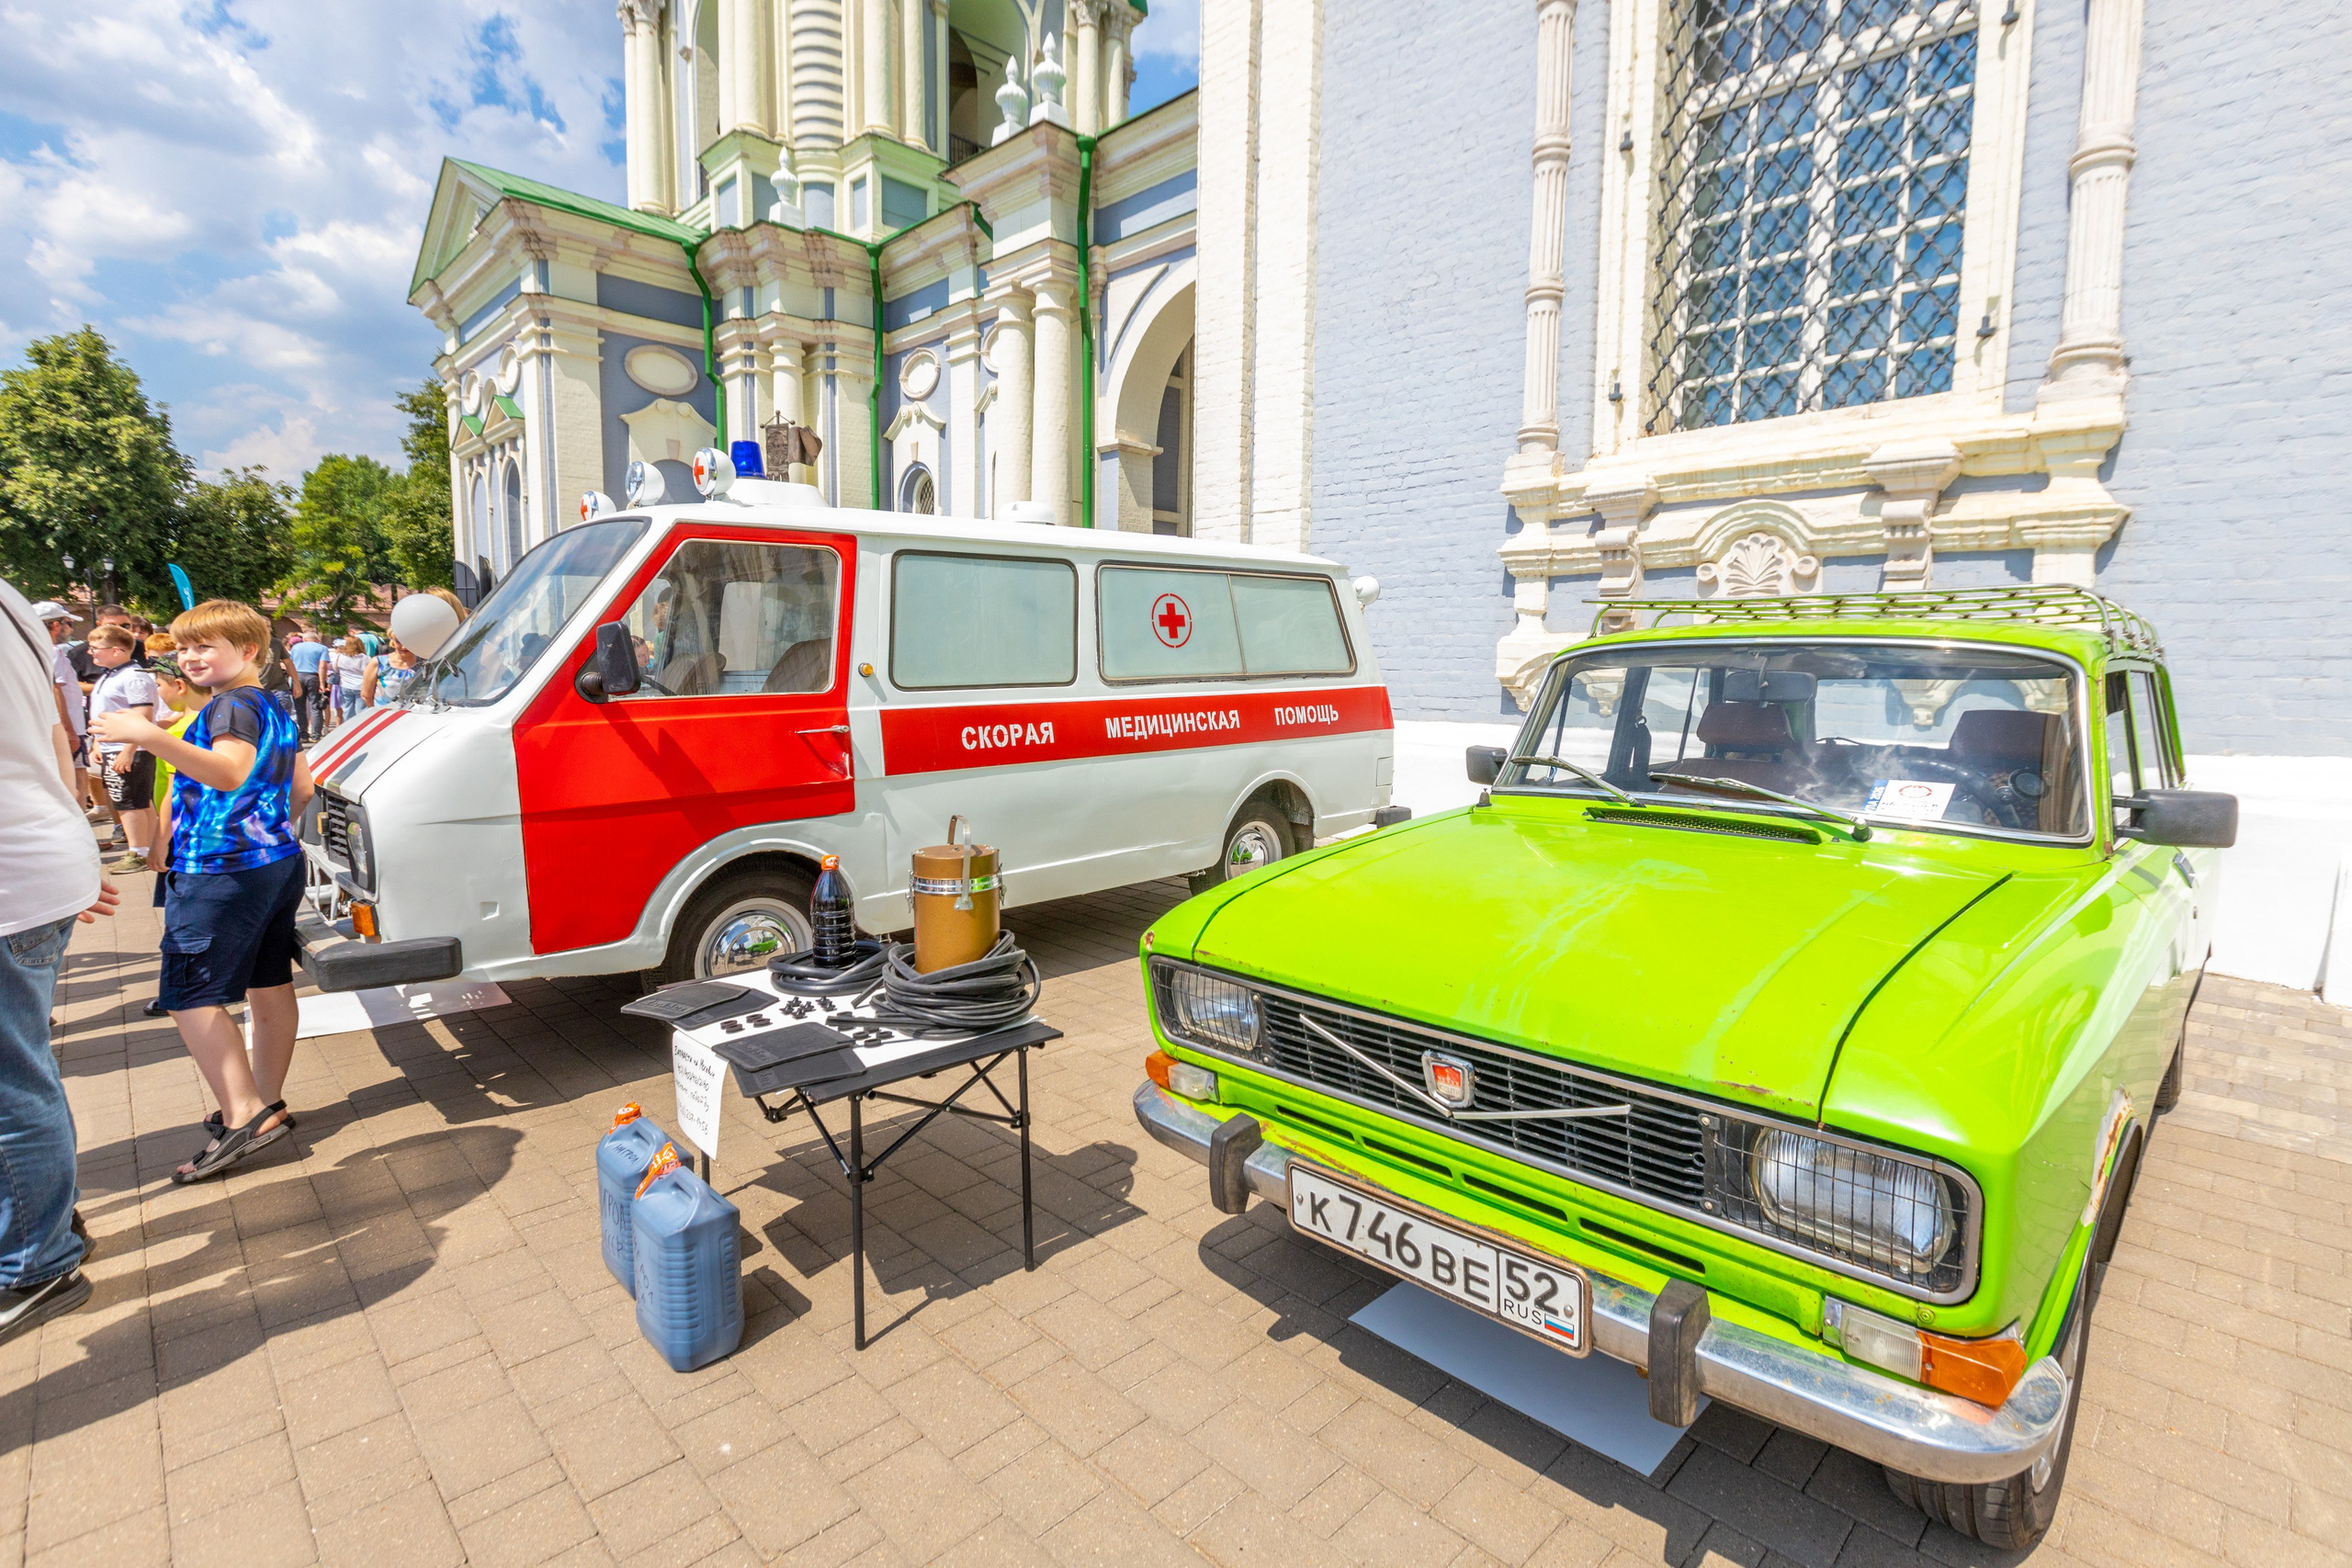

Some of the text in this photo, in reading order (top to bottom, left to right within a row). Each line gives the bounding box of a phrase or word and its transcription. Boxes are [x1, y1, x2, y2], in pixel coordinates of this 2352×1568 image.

[961, 704, 1340, 750] СКОРАЯ МЕДИЦИНСКАЯ ПОМОЩЬ
[1505, 1257, 1560, 1316] 52
[1503, 1297, 1543, 1325] RUS
